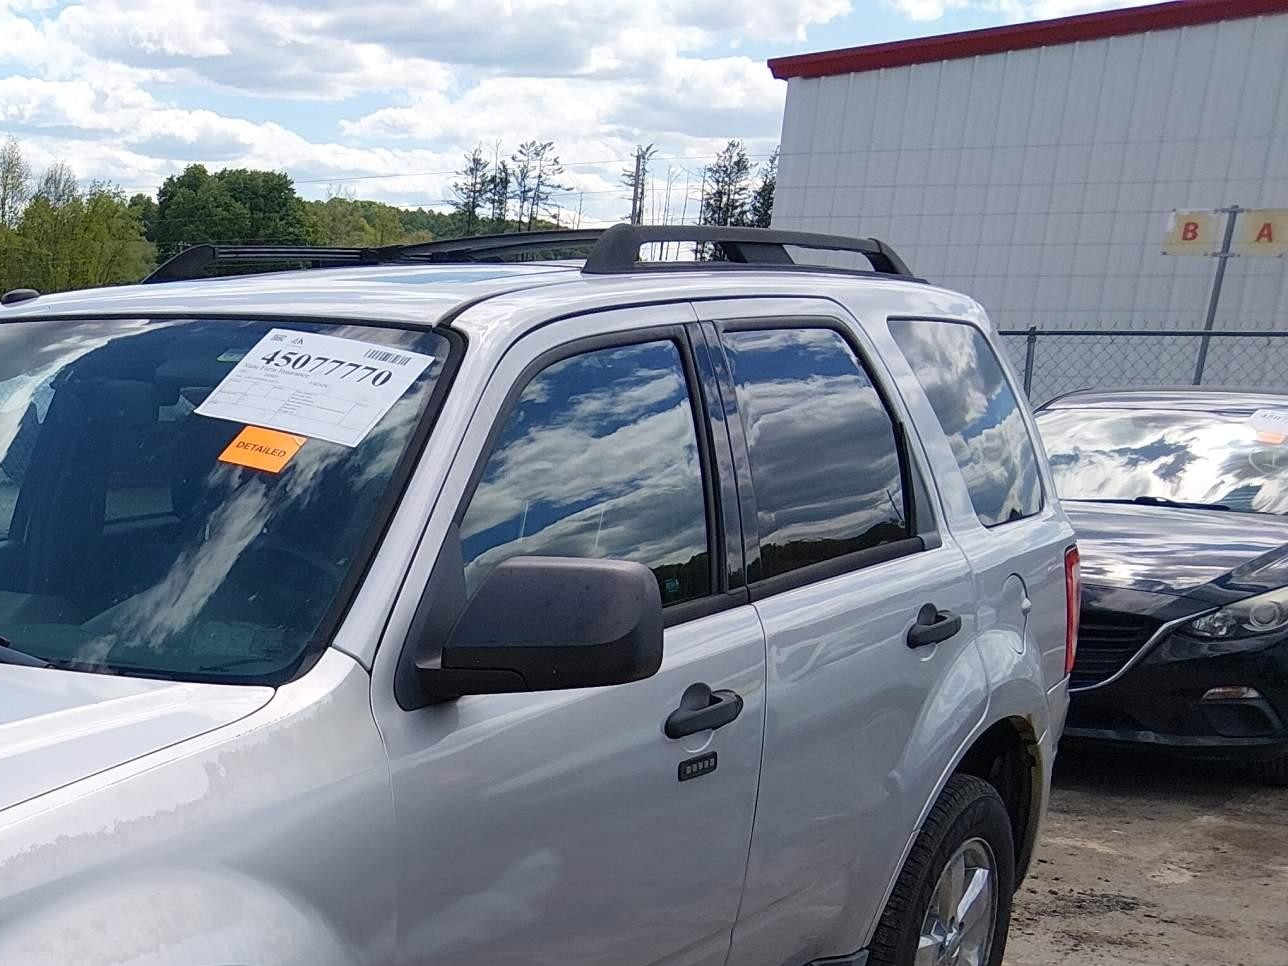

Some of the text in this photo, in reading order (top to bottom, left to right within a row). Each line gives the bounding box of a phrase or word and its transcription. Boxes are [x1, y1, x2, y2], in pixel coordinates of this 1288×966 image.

[1182, 222, 1199, 241] B
[1255, 223, 1273, 243] A
[261, 349, 393, 388] 45077770
[235, 440, 287, 458] DETAILED
